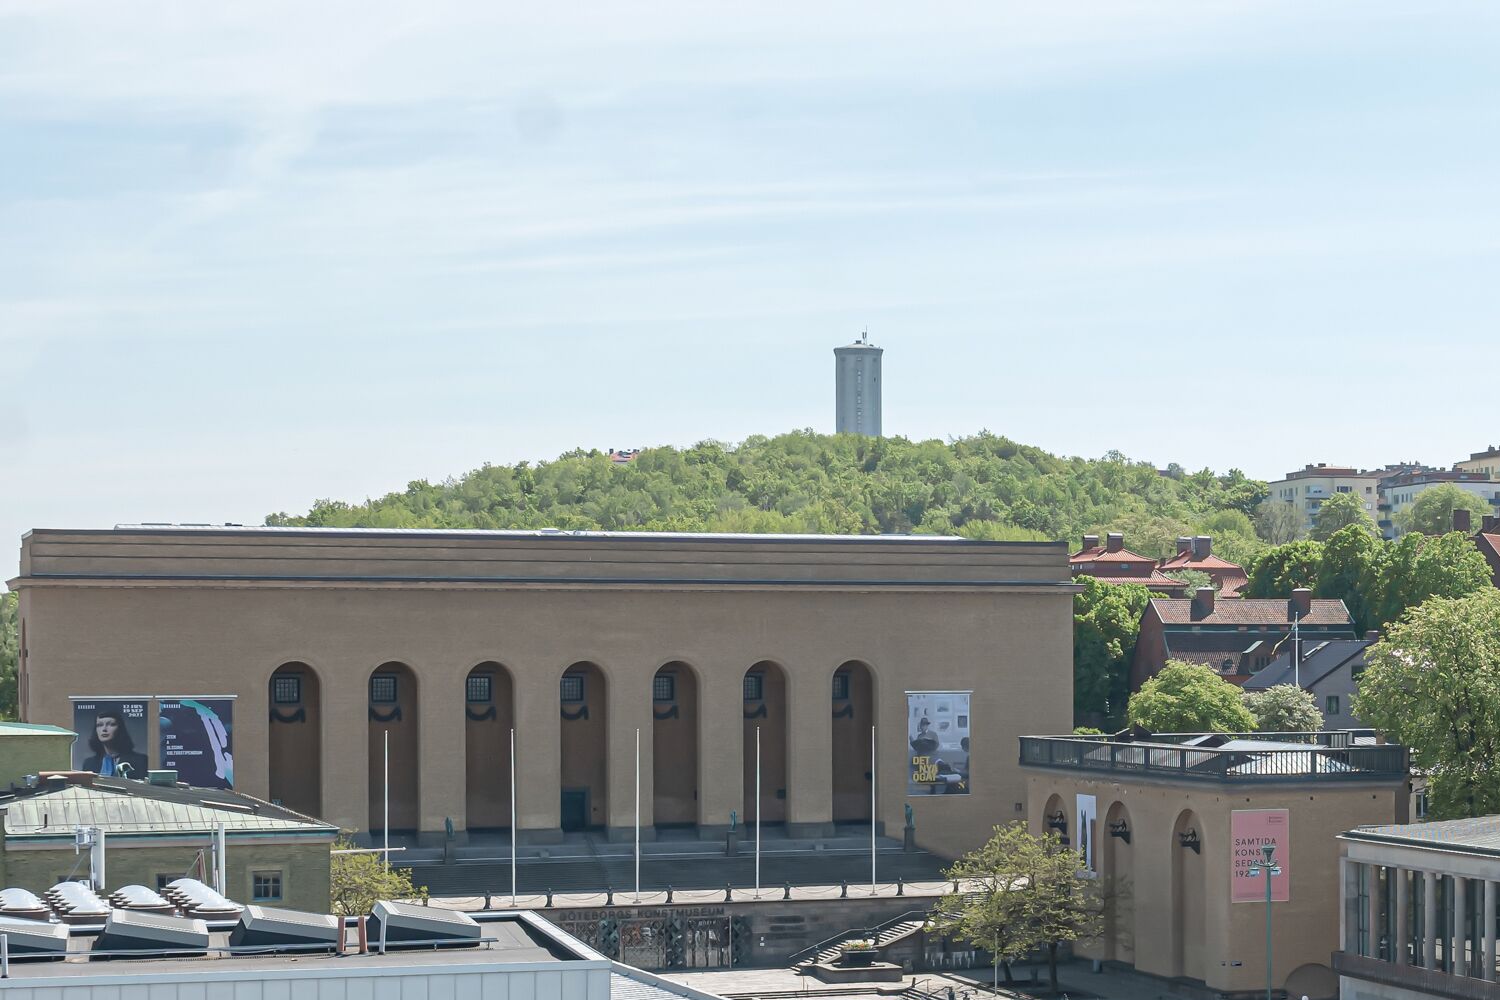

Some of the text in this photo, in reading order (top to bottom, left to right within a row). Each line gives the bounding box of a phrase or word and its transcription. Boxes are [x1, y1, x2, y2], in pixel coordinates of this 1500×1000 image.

[912, 756, 930, 765] DET
[1235, 838, 1277, 846] SAMTIDA
[559, 907, 725, 921] GÖTEBORGS KONSTMUSEUM
